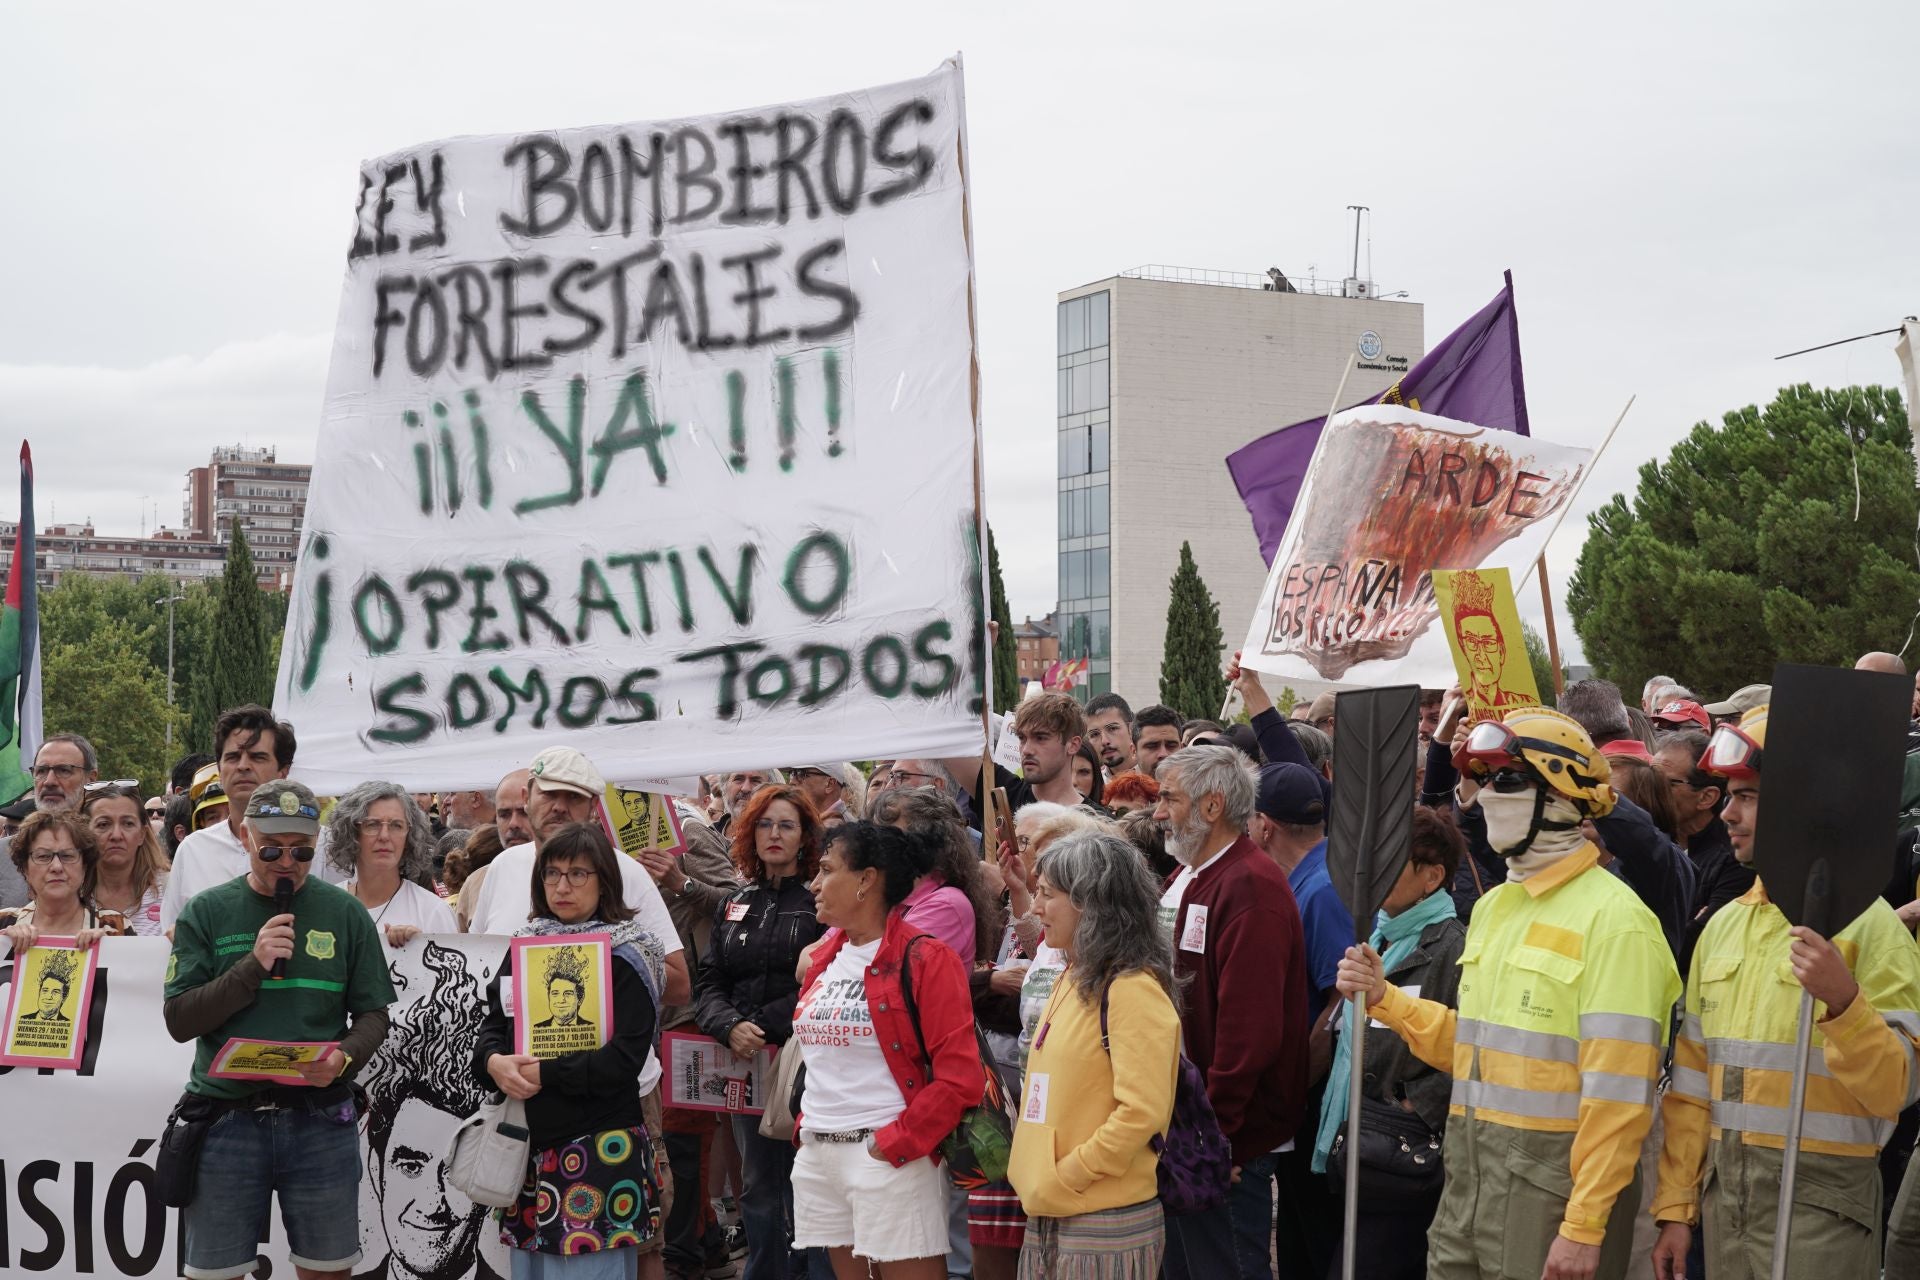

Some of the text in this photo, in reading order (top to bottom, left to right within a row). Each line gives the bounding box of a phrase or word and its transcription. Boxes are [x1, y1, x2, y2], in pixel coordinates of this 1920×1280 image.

[500, 97, 938, 238] BOMBEROS
[372, 240, 862, 381] FORESTALES
[1357, 361, 1408, 373] Económico y Social
[1386, 354, 1408, 365] Consejo
[1399, 448, 1551, 519] ARDE
[1282, 559, 1401, 610] ESPAÑA
[1271, 605, 1307, 644] LOS
[364, 665, 662, 745] SOMOS
[622, 832, 639, 843] VIERNES
[533, 1027, 565, 1035] CONCENTRACIÓN
[795, 1022, 873, 1037] ENTELCÉSPED
[532, 1042, 550, 1050] CORTES
[550, 1041, 556, 1049] DE
[556, 1040, 580, 1049] CASTILLA
[584, 1039, 596, 1047] LEÓN
[533, 1034, 556, 1043] VIERNES
[557, 1034, 566, 1042] 29
[571, 1032, 589, 1041] 10:00
[800, 1034, 850, 1047] MILAGROS
[729, 1082, 738, 1108] CCOO
